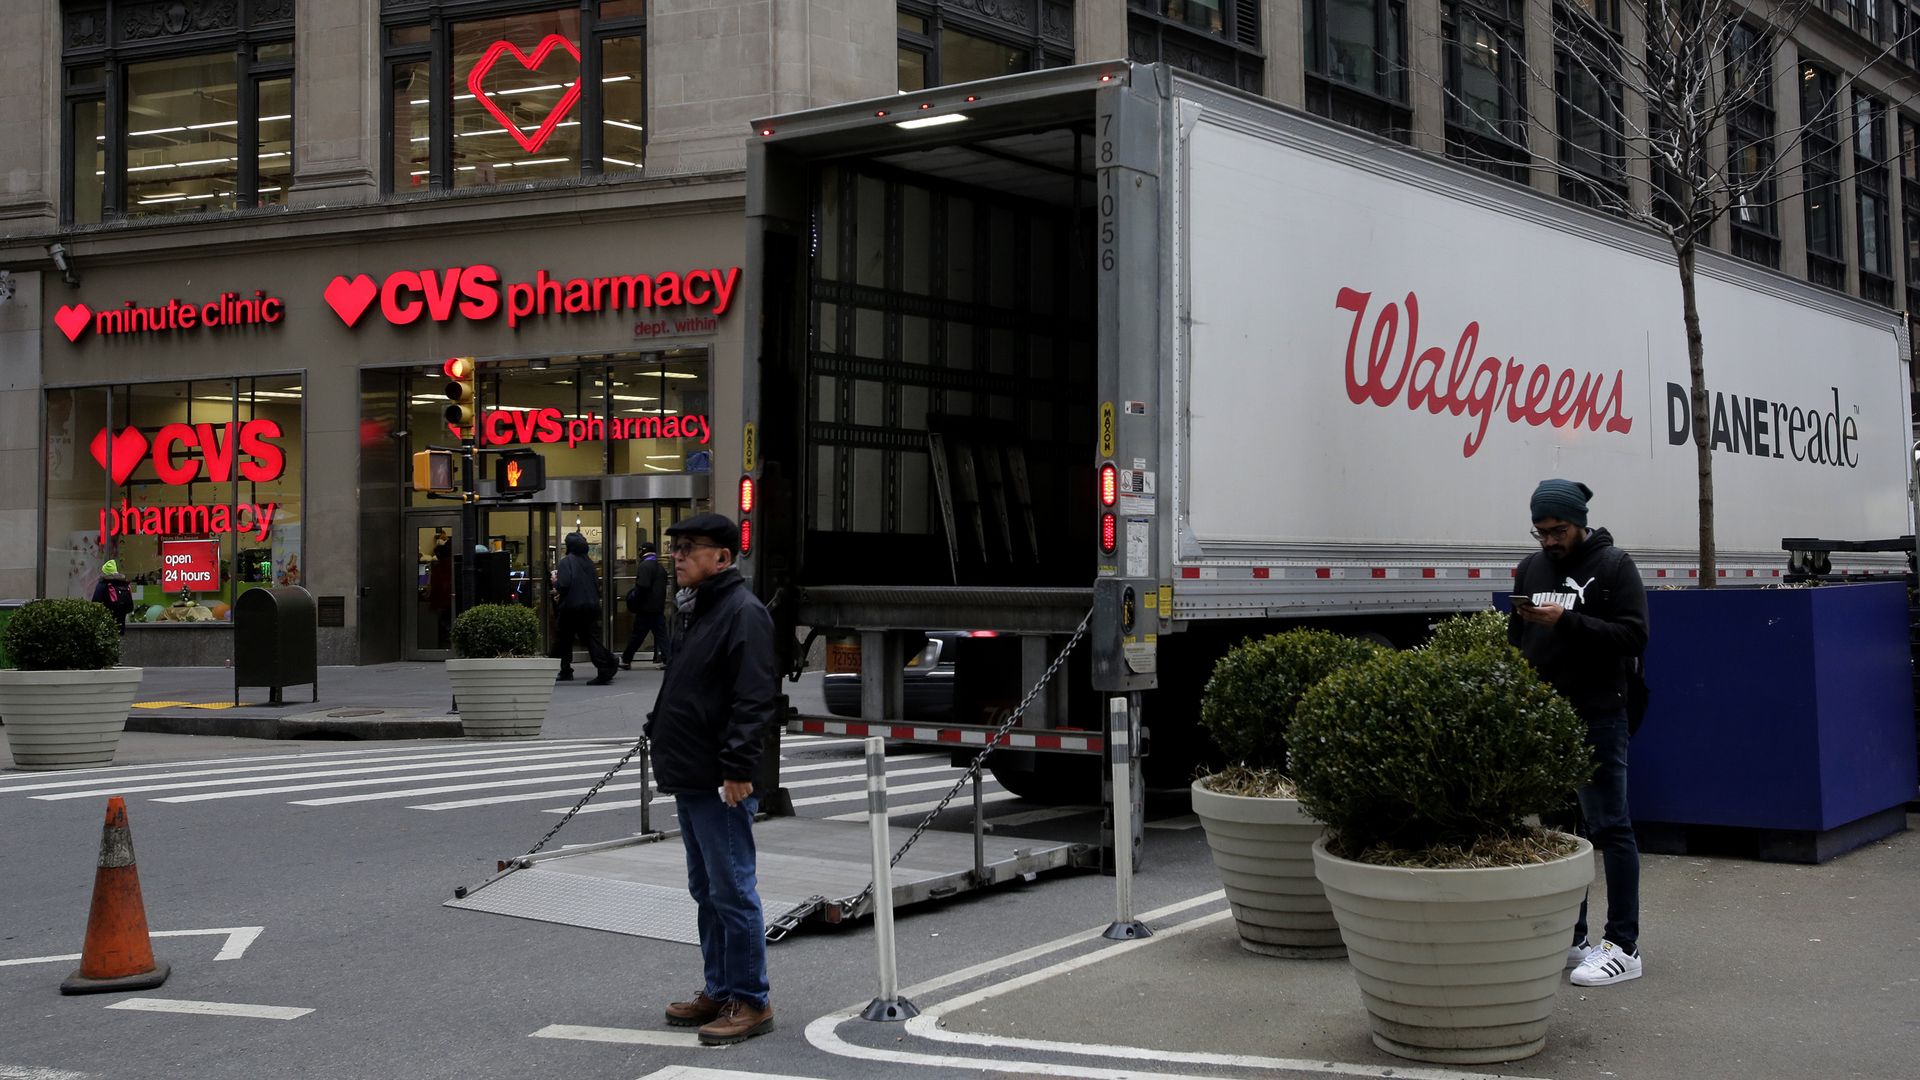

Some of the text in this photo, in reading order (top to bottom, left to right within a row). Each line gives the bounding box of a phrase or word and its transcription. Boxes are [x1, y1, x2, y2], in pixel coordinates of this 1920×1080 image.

[1101, 113, 1115, 272] 781056
[96, 291, 280, 335] minute clinic
[380, 264, 740, 328] CVS pharmacy
[634, 317, 717, 337] dept. within
[1336, 287, 1633, 458] Walgreens
[485, 407, 711, 449] CVS pharmacy
[1103, 409, 1112, 451] MAXON
[152, 419, 284, 486] CVS
[99, 499, 275, 545] pharmacy
[165, 554, 192, 567] open
[165, 569, 211, 582] 24 hours
